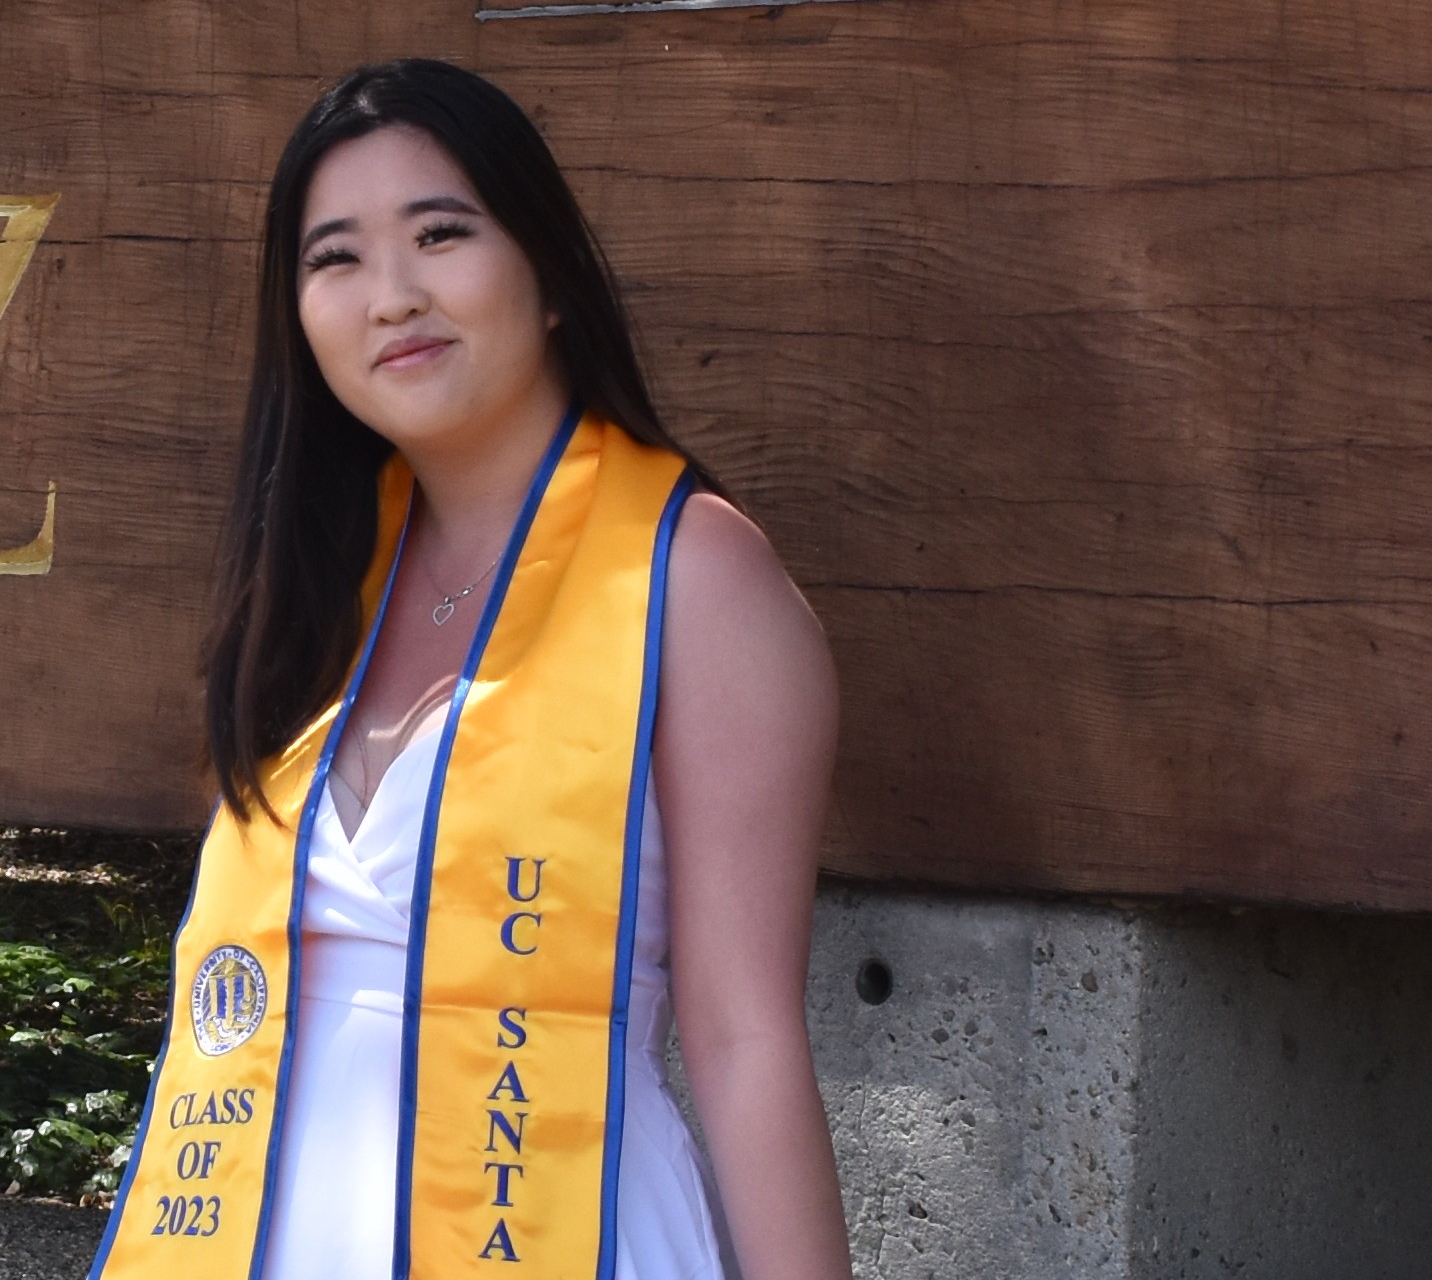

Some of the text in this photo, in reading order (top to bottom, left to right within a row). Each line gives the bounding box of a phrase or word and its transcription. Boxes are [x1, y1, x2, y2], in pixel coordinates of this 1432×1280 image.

[500, 856, 546, 955] UC
[170, 1088, 255, 1129] CLASS
[478, 1007, 530, 1262] SANTA
[177, 1140, 221, 1180] OF
[150, 1194, 222, 1237] 2023
